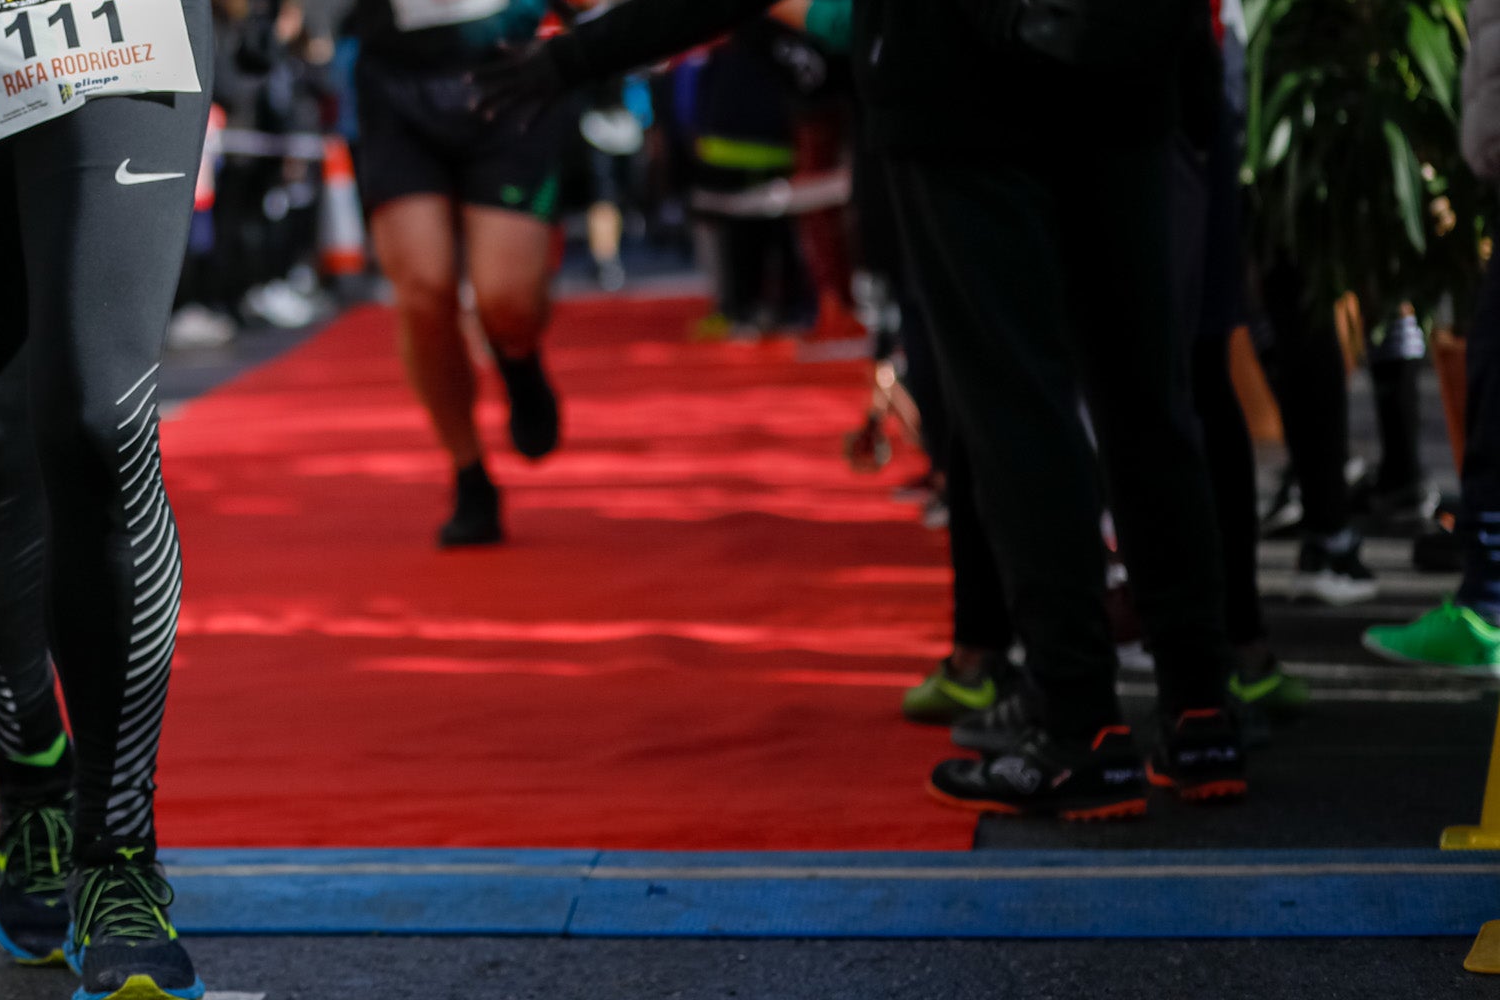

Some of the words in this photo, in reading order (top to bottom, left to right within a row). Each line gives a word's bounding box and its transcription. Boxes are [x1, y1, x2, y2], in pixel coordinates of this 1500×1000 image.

[4, 0, 123, 60] 111
[2, 62, 49, 98] RAFA
[51, 43, 155, 79] RODRÍGUEZ
[74, 75, 119, 90] olimpo
